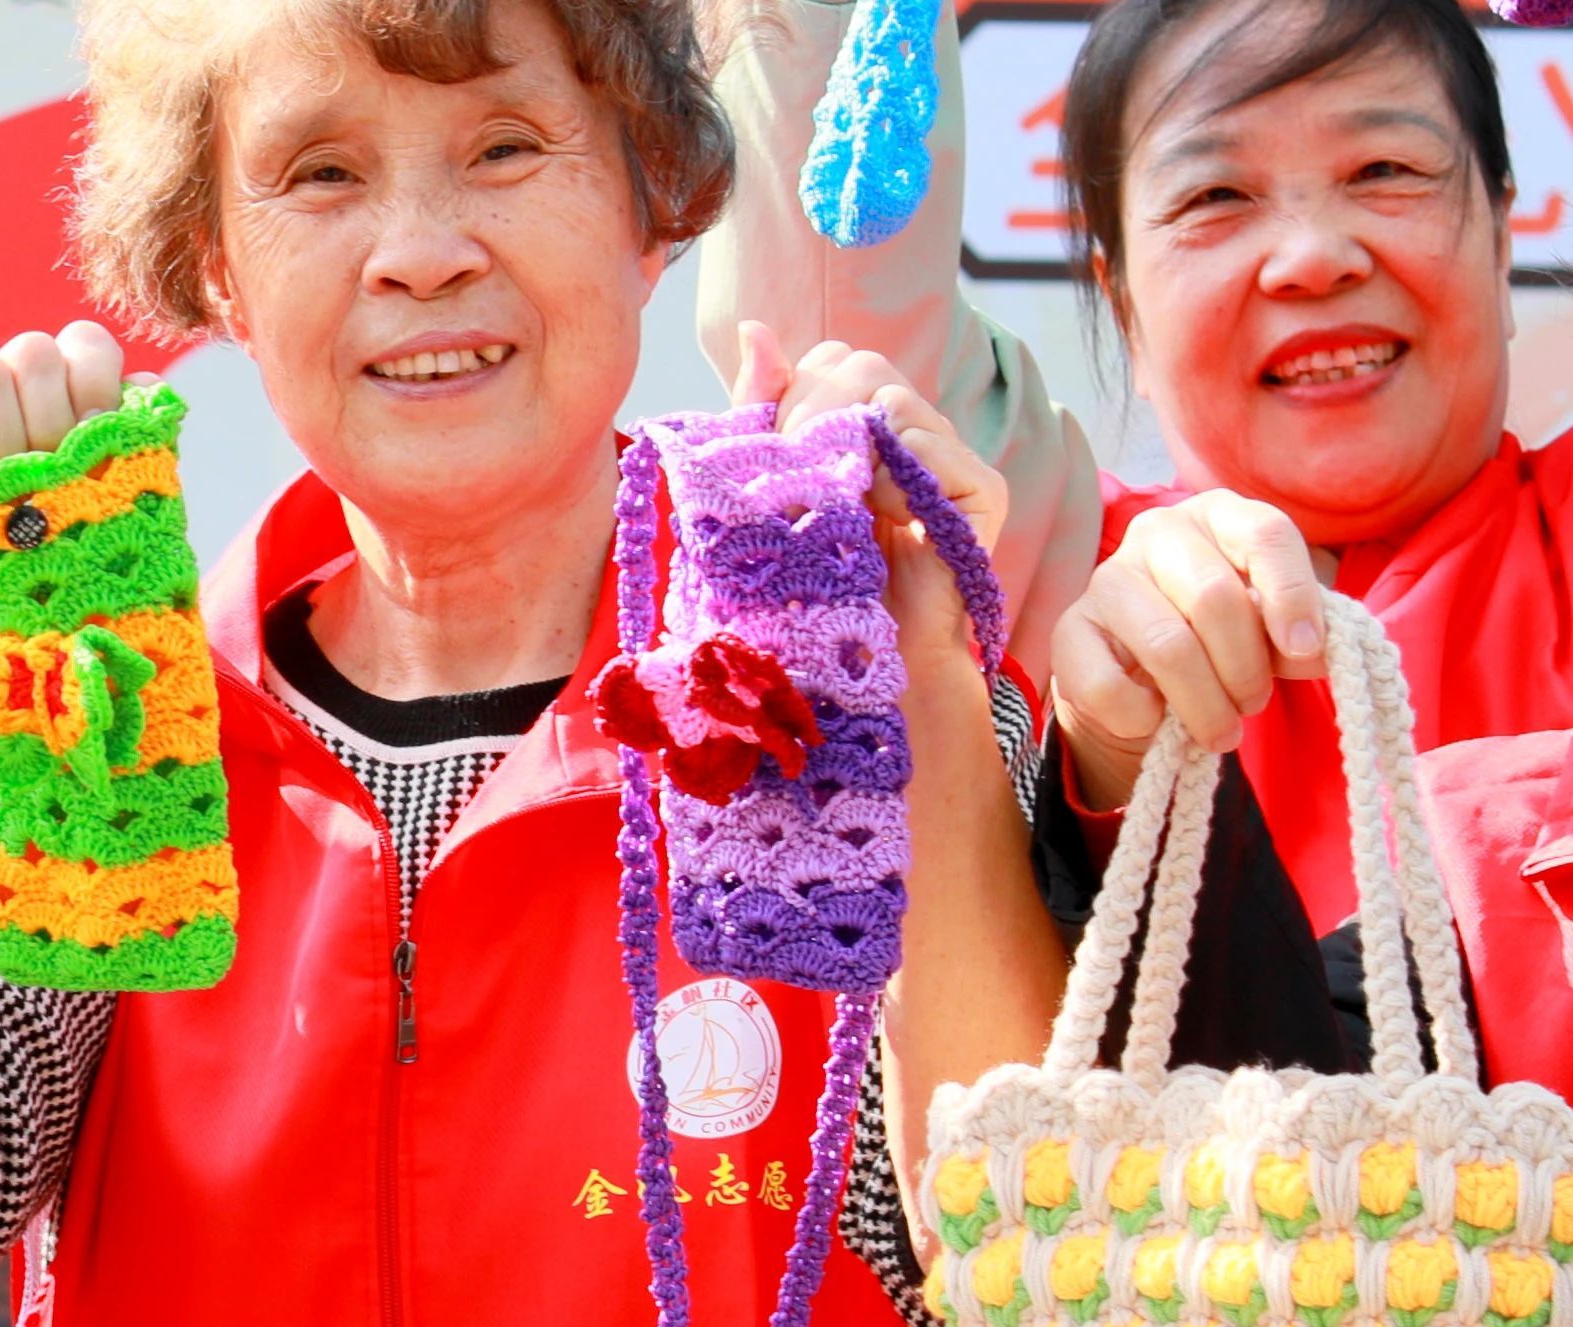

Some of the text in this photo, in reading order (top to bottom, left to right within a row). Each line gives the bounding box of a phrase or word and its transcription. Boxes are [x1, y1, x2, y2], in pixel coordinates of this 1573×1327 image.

[700, 1065, 778, 1135] COMMUNITY
[571, 1151, 807, 1221] 金志愿
